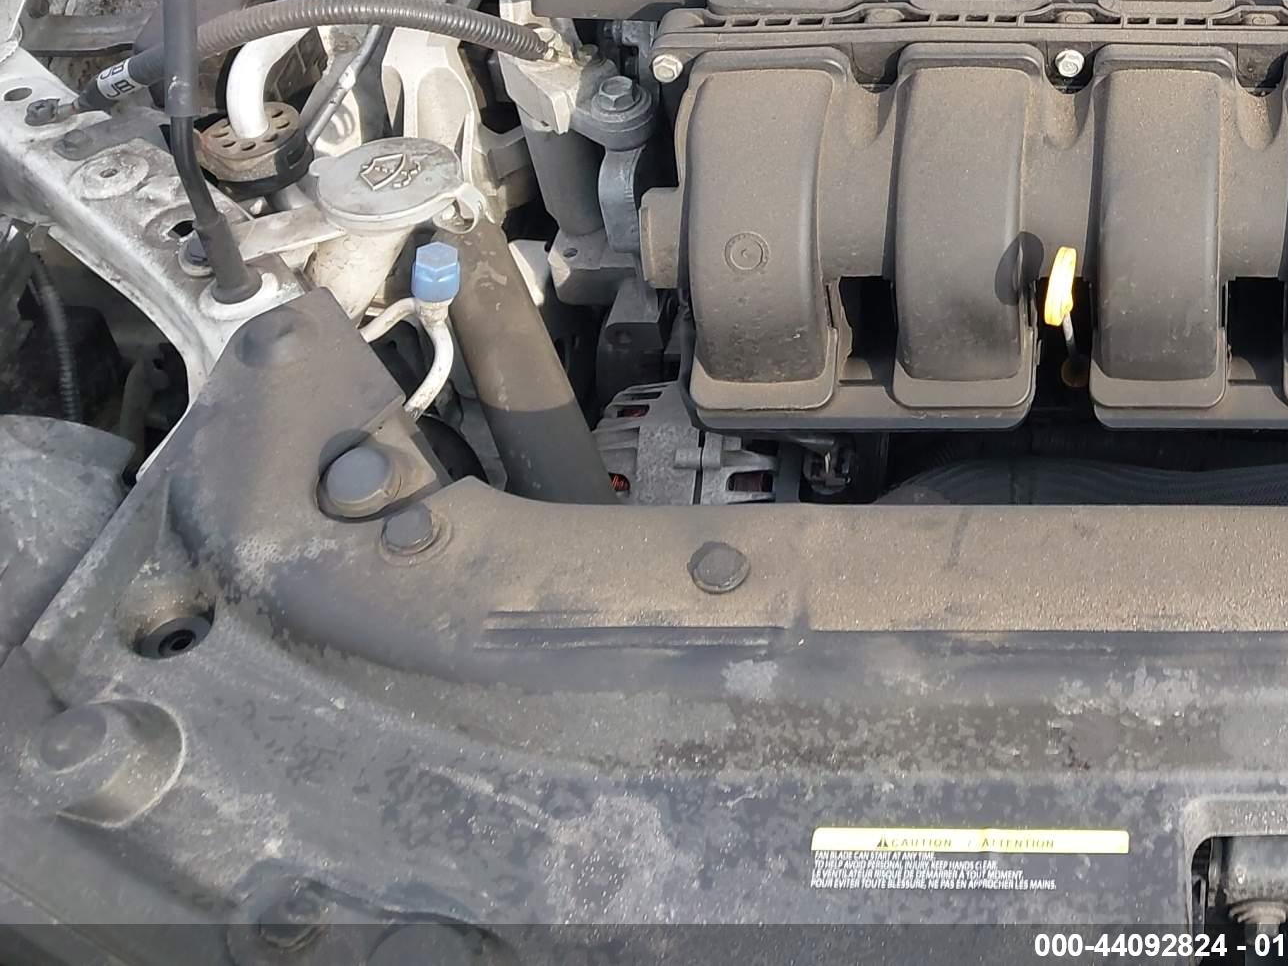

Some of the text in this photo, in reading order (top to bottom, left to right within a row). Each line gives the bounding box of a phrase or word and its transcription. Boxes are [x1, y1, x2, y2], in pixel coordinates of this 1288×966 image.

[107, 79, 135, 98] JB
[890, 838, 952, 848] CAUTION
[982, 838, 1055, 848] ATTENTION
